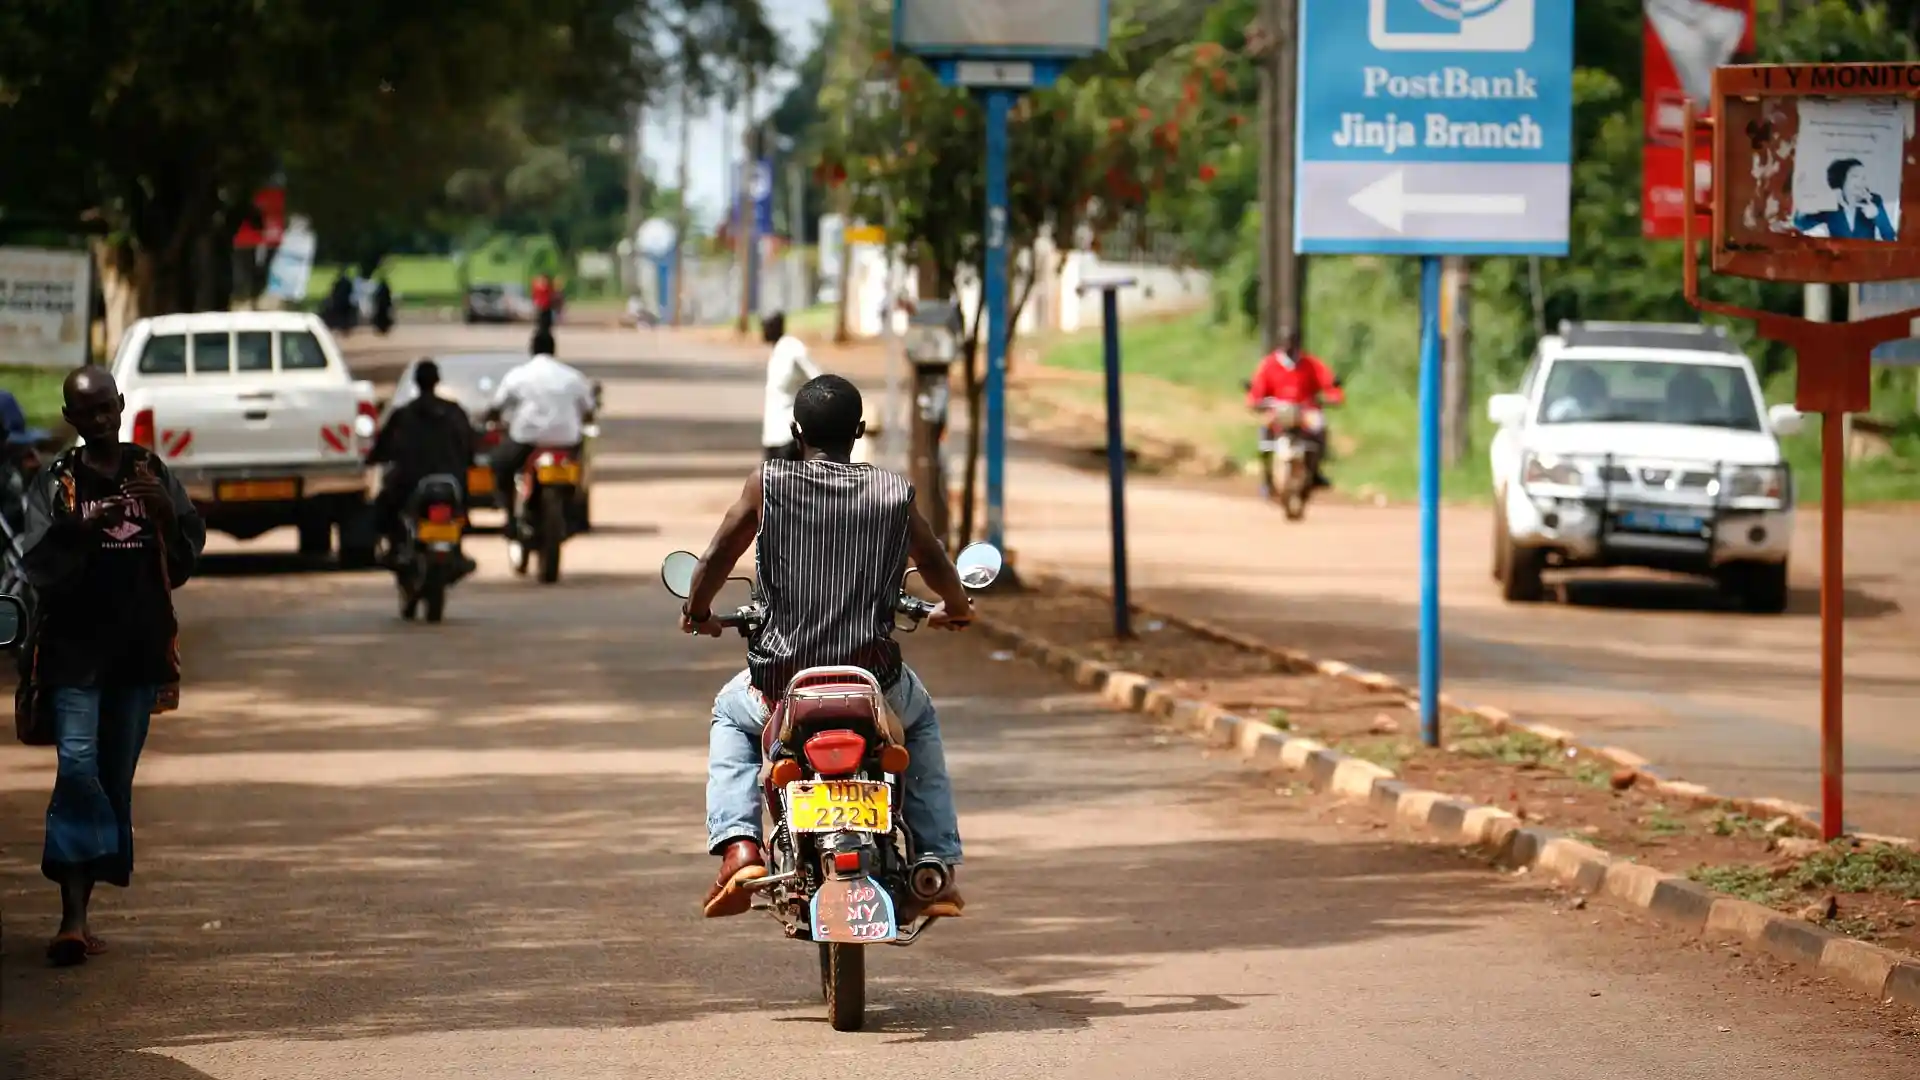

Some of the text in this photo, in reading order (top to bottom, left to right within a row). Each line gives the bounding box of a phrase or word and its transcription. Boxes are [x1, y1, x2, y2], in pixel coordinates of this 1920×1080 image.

[1363, 66, 1538, 98] PostBank
[1332, 112, 1543, 154] Jinja Branch
[827, 783, 876, 806] UDK
[816, 806, 878, 828] 222J
